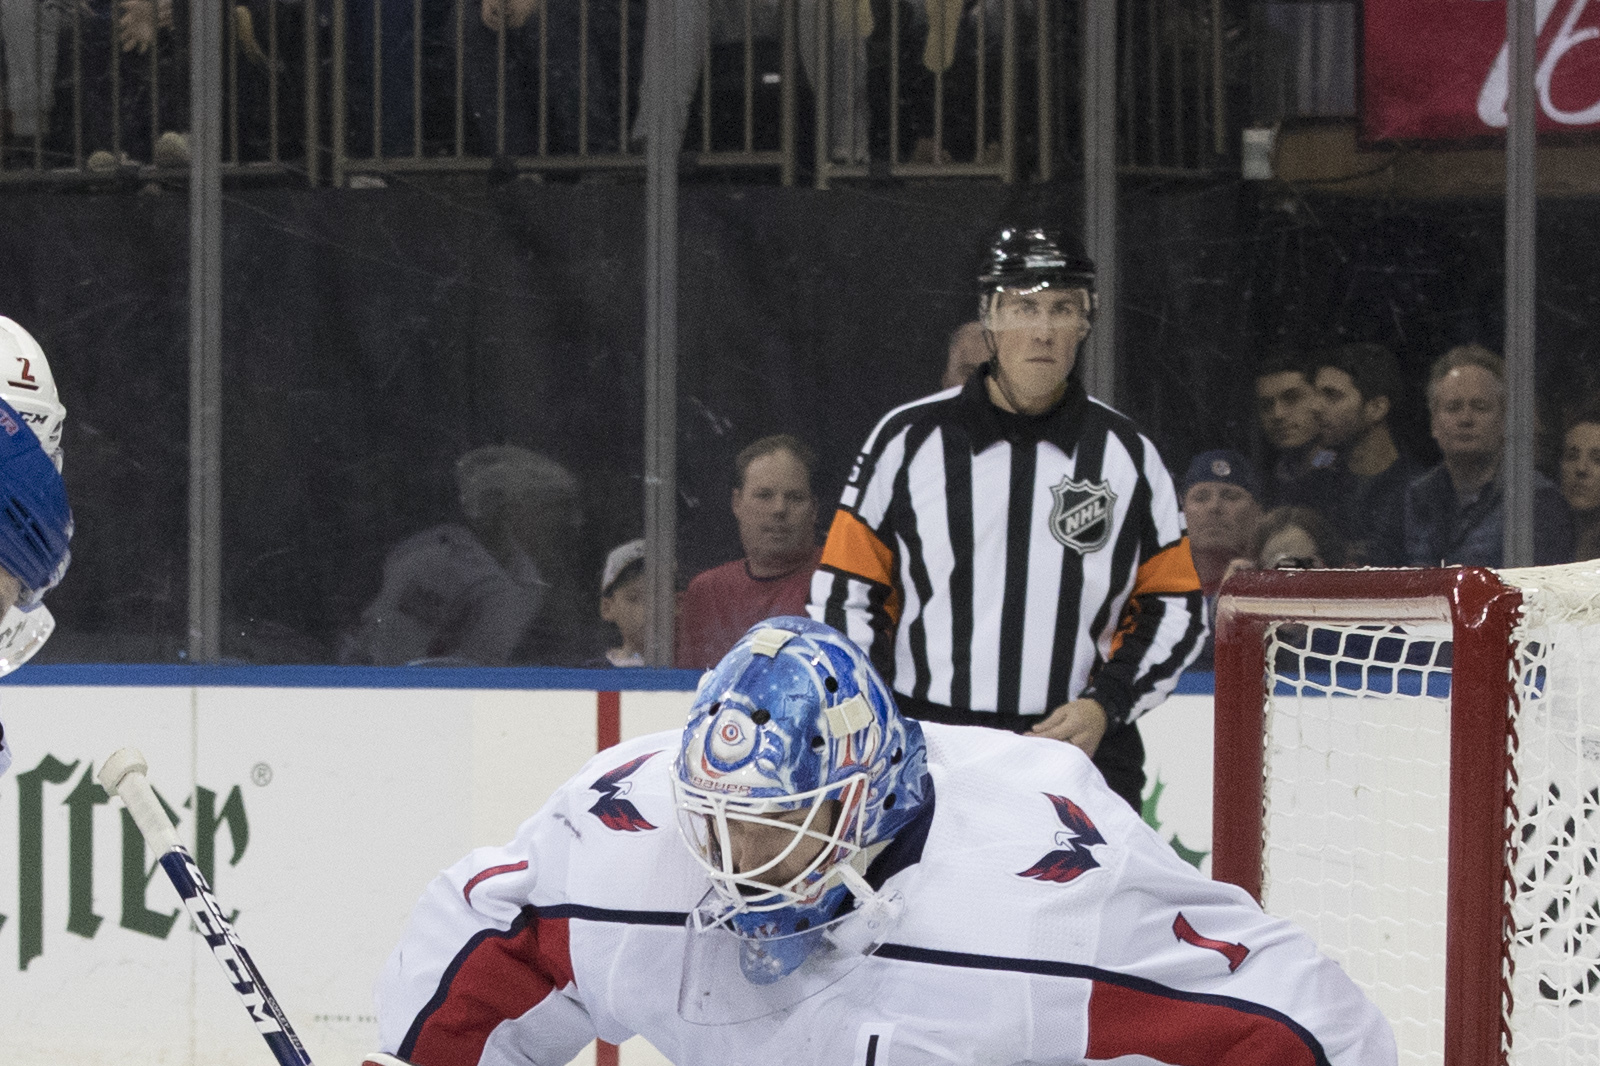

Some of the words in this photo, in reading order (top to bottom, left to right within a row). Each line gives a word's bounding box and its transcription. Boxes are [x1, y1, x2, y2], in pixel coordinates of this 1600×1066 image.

[16, 357, 36, 382] 2
[1065, 502, 1105, 534] NHL
[184, 886, 283, 1034] CCM
[1171, 910, 1251, 974] 1
